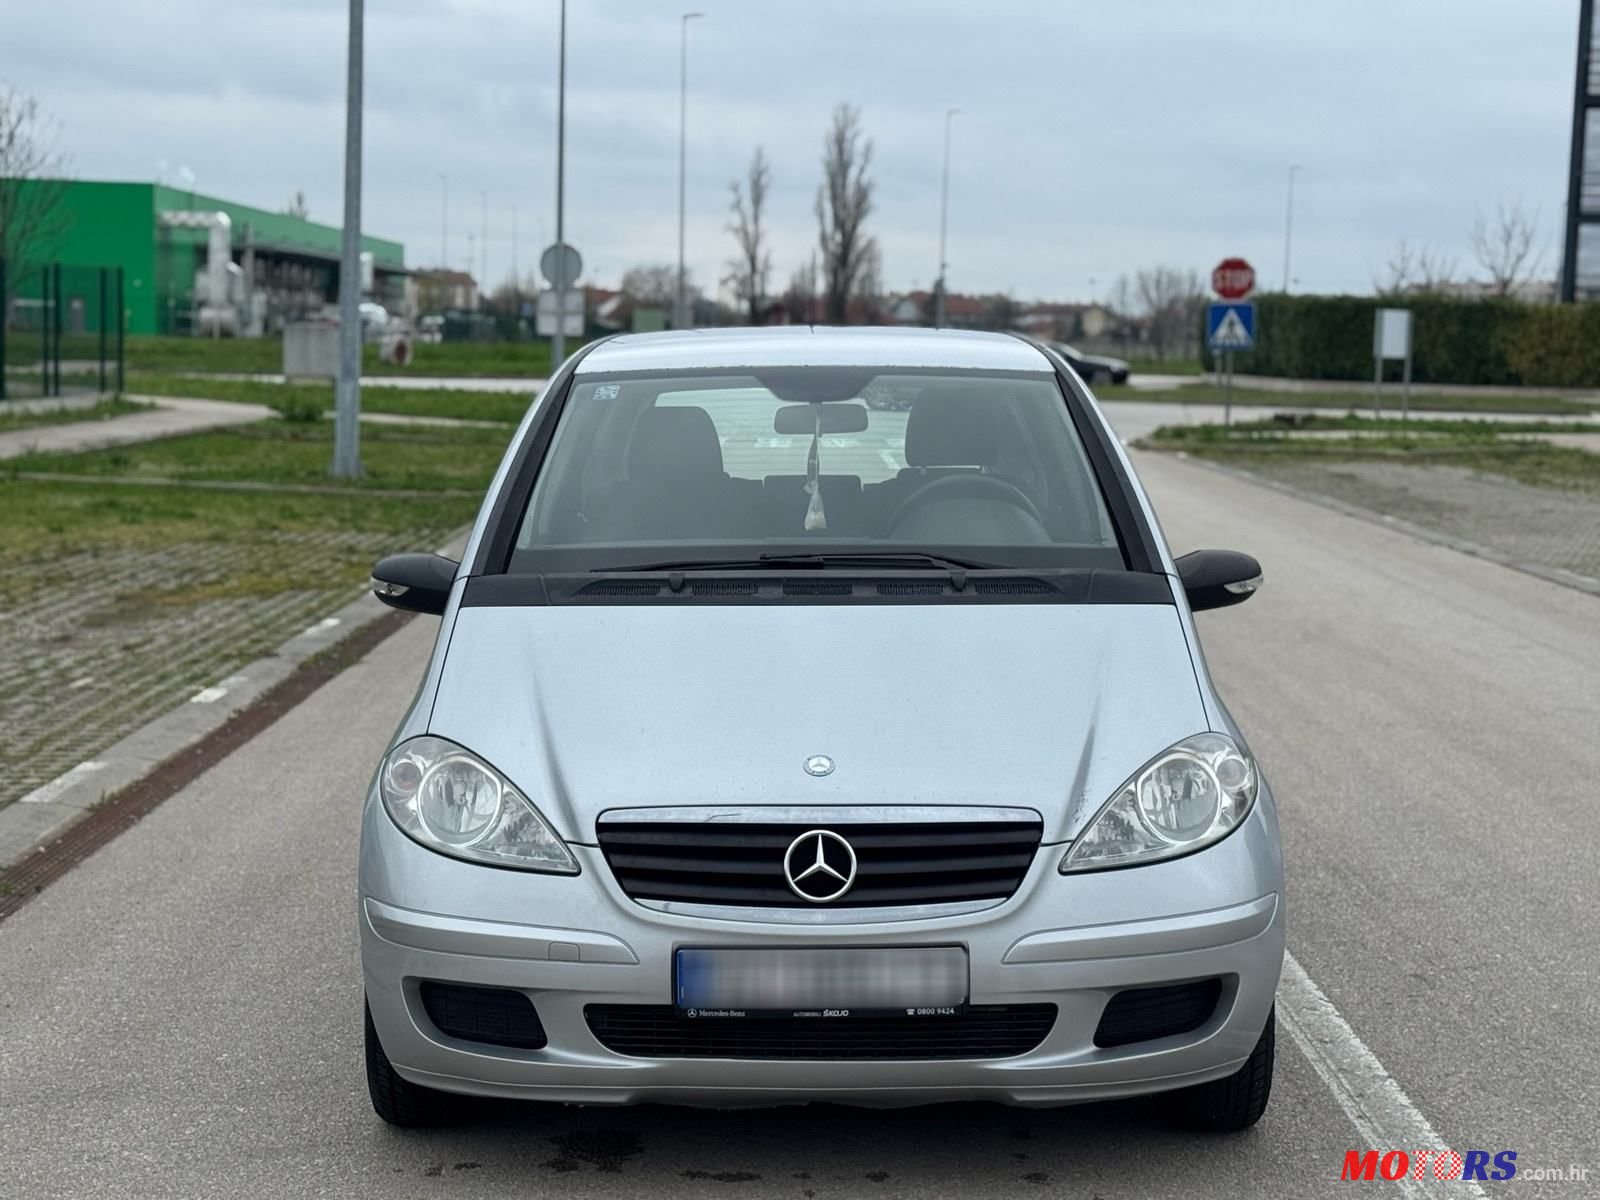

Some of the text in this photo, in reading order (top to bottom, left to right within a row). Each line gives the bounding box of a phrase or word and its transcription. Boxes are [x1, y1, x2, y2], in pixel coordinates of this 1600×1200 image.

[1213, 270, 1253, 289] STOP
[699, 1009, 746, 1017] Mercedes-Benz
[823, 1008, 849, 1017] ŠKOJO
[917, 1007, 935, 1015] 0800
